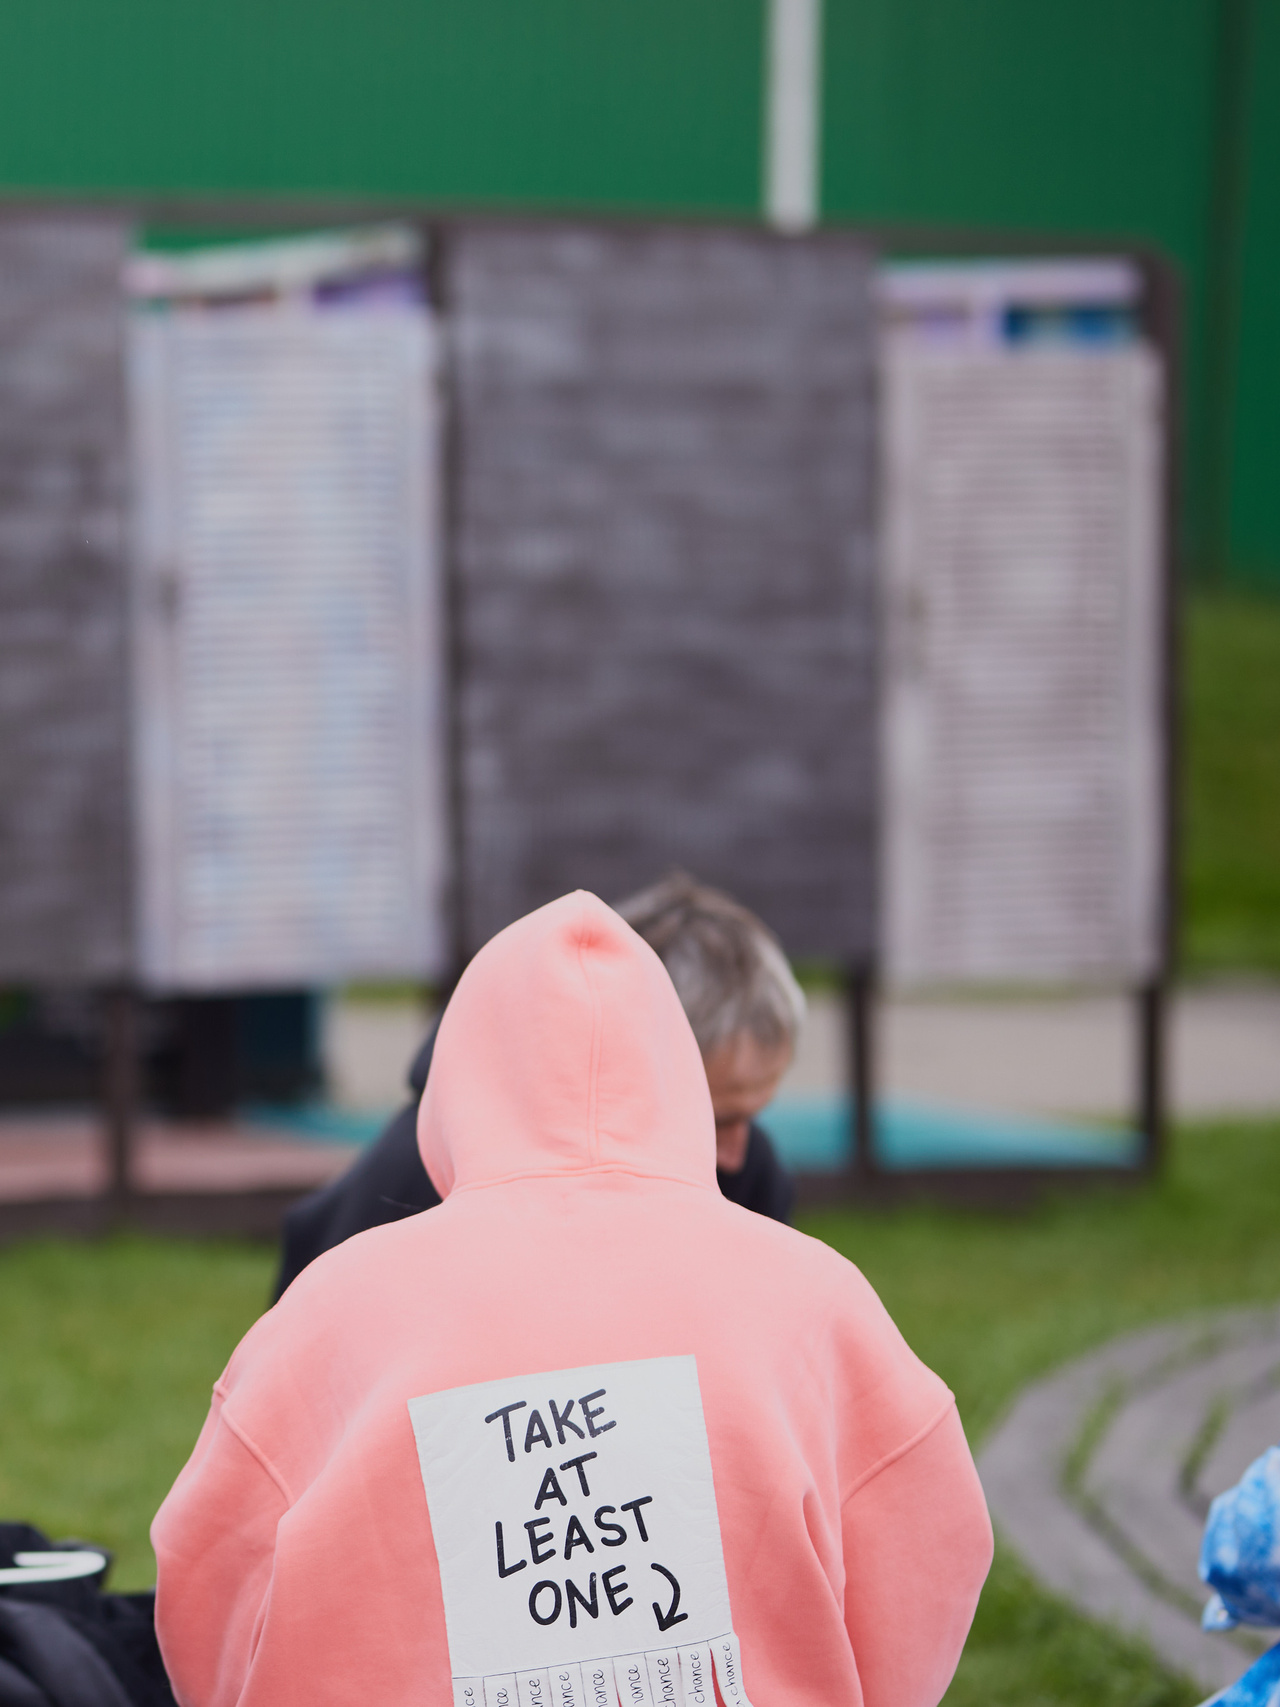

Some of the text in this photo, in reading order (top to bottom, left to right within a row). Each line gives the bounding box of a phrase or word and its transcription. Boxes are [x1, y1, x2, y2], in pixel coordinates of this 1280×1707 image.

[484, 1388, 617, 1463] TAKE
[534, 1451, 598, 1511] AT
[494, 1495, 654, 1580] LEAST
[527, 1563, 635, 1630] ONE
[687, 1650, 706, 1704] chance
[722, 1641, 739, 1696] chance
